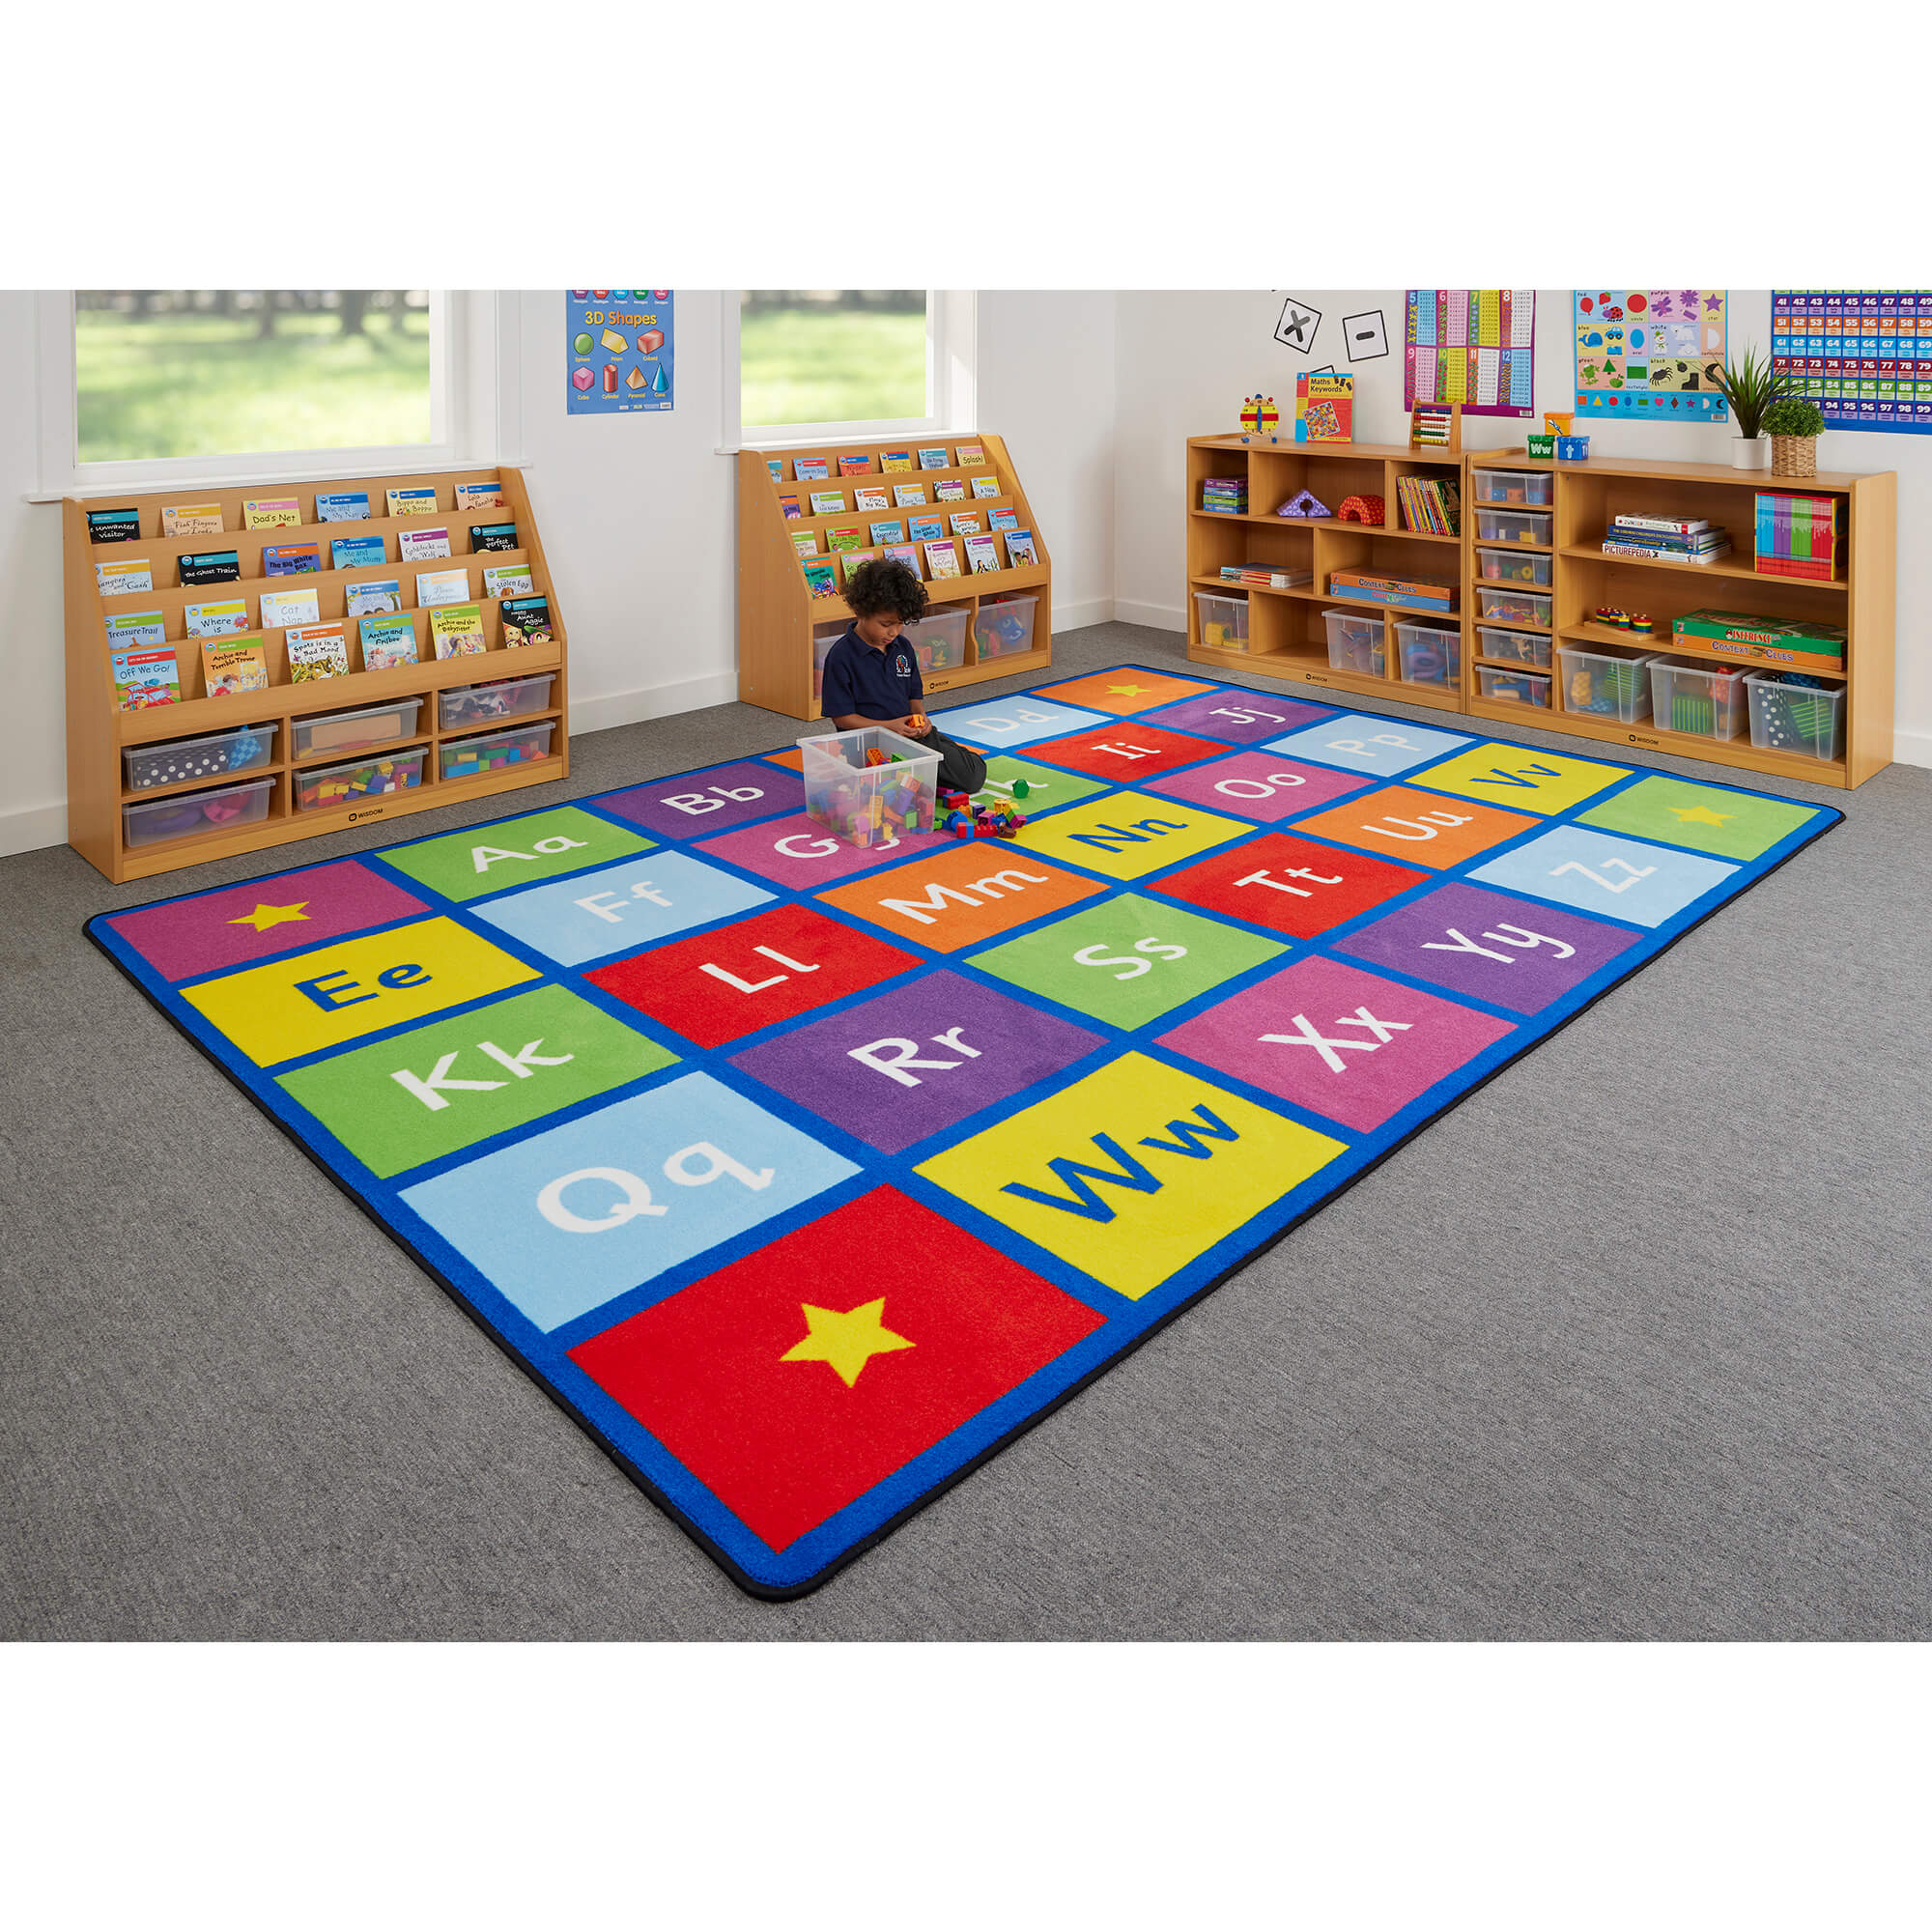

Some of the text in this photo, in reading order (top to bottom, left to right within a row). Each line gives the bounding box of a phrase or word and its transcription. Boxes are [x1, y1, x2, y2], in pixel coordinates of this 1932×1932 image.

[1410, 292, 1416, 302] 5
[1439, 291, 1446, 301] 6
[1471, 292, 1478, 302] 7
[1502, 291, 1511, 301] 8
[585, 310, 658, 328] 3D Shapes
[1407, 348, 1415, 358] 9
[1438, 351, 1447, 359] 10
[1470, 349, 1477, 359] 11
[1502, 351, 1511, 361] 12
[1530, 442, 1551, 454] Ww
[192, 519, 217, 527] Fingers
[252, 514, 296, 525] Dad's Net
[486, 538, 509, 548] Perfect
[1605, 544, 1652, 558] PICTUREPEDIA
[293, 555, 313, 564] White
[497, 580, 529, 590] Stolen Egg
[280, 606, 298, 615] Cat
[201, 618, 232, 628] Where
[281, 617, 302, 626] Nap
[437, 619, 455, 629] Archie
[525, 617, 544, 626] Aggie
[108, 628, 141, 639] Treasure
[368, 630, 389, 640] Archie
[1731, 629, 1773, 644] INFERENCE
[294, 643, 315, 653] Spots
[1711, 640, 1794, 662] CONTEXT CLUES
[213, 652, 235, 661] Archie
[120, 664, 170, 680] Off We Go!
[211, 660, 235, 671] Terrible
[966, 709, 1059, 732] Dd
[1208, 706, 1287, 724] Jj
[1090, 742, 1161, 760] Ii
[1324, 734, 1421, 757] Pp
[1469, 763, 1562, 789] Vv
[1214, 773, 1306, 799] Oo
[660, 785, 765, 816] Bb
[1360, 810, 1473, 841] Uu
[1066, 818, 1189, 854] Nn
[471, 836, 588, 874] Aa
[1233, 867, 1344, 897] Tt
[1548, 857, 1658, 894] Zz
[573, 881, 673, 923] Ff
[877, 869, 1049, 924] Mm
[1421, 923, 1577, 964] Yy
[1073, 937, 1187, 980] Ss
[698, 945, 820, 994] Ll
[293, 963, 433, 1012] Ee
[1257, 1006, 1414, 1074] Xx
[846, 1027, 982, 1088] Rr
[390, 1037, 575, 1111] Kk
[999, 1103, 1239, 1224] Ww
[536, 1141, 775, 1234] Qq
